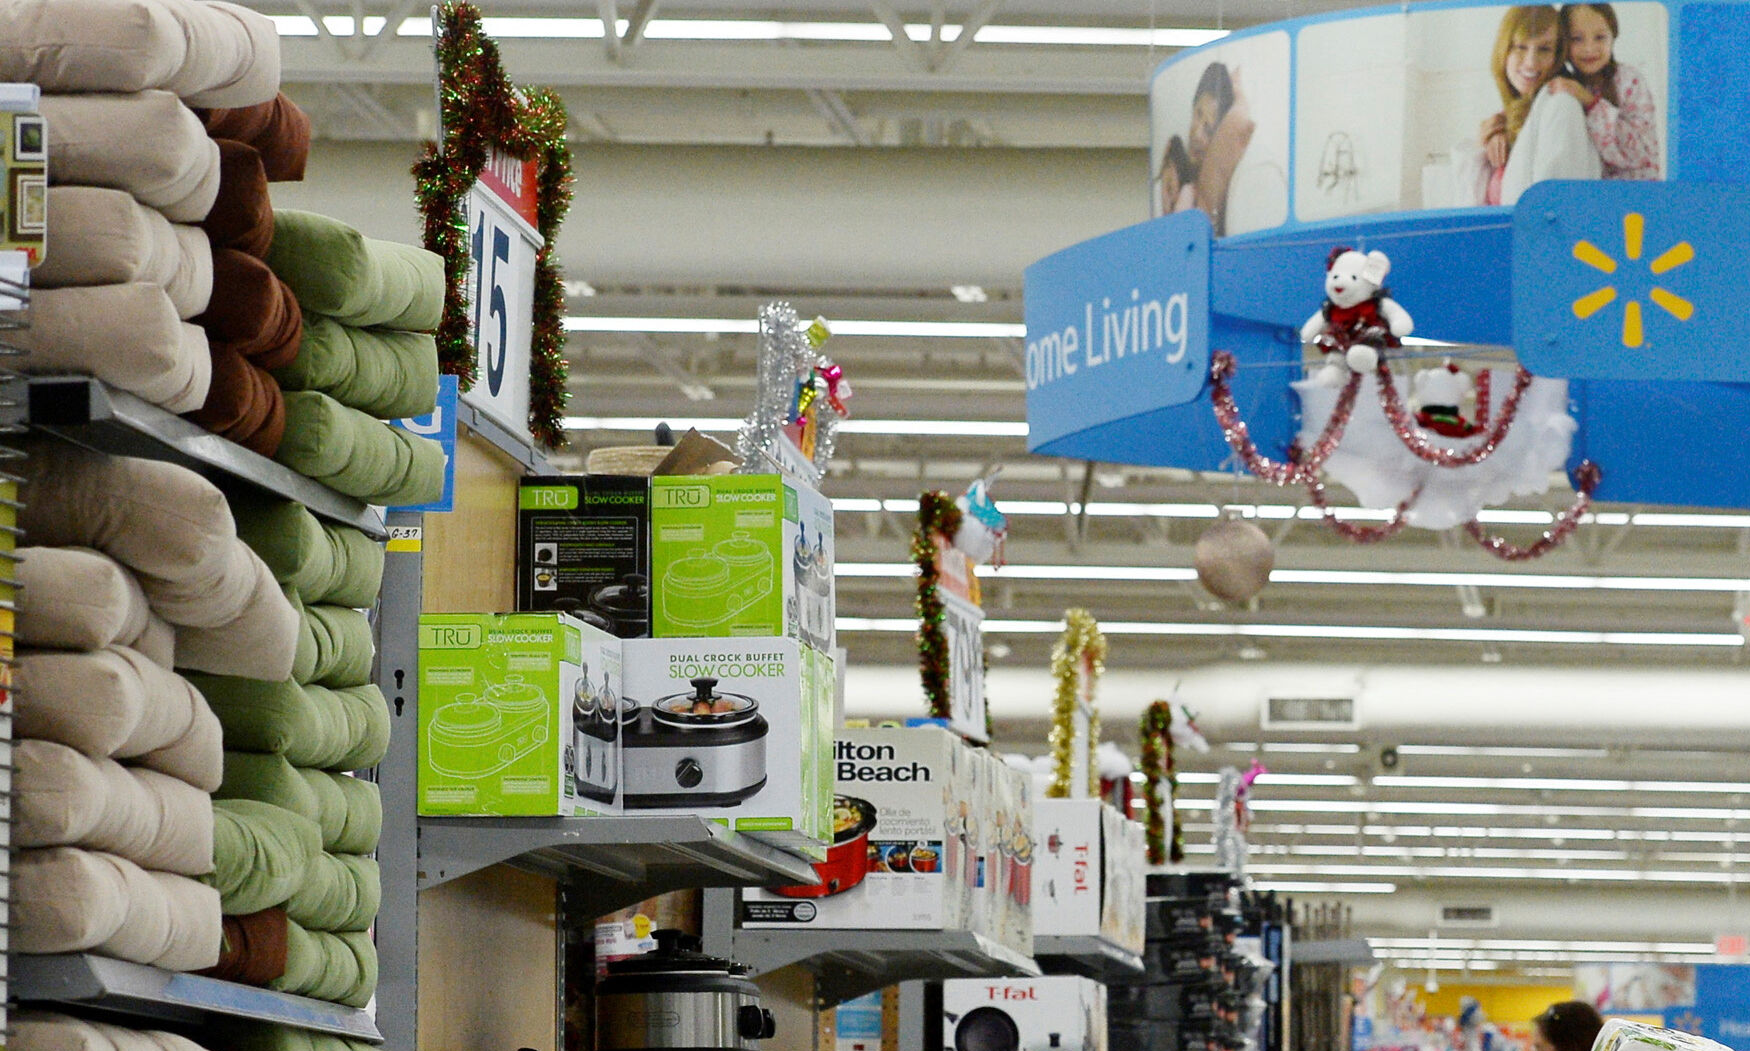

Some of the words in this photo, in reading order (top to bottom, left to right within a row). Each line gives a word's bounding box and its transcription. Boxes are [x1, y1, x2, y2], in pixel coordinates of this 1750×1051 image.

[1025, 322, 1078, 390] ome
[1085, 288, 1188, 363] Living
[609, 496, 645, 505] COOKER
[514, 633, 553, 643] COOKER
[669, 653, 697, 663] DUAL
[703, 653, 741, 663] CROCK
[745, 653, 784, 663] BUFFET
[669, 663, 715, 679] SLOW
[717, 663, 785, 679] COOKER
[832, 739, 896, 761] ilton
[837, 761, 931, 783] Beach
[1073, 843, 1090, 895] T-fal
[984, 985, 1038, 1001] T-fal
